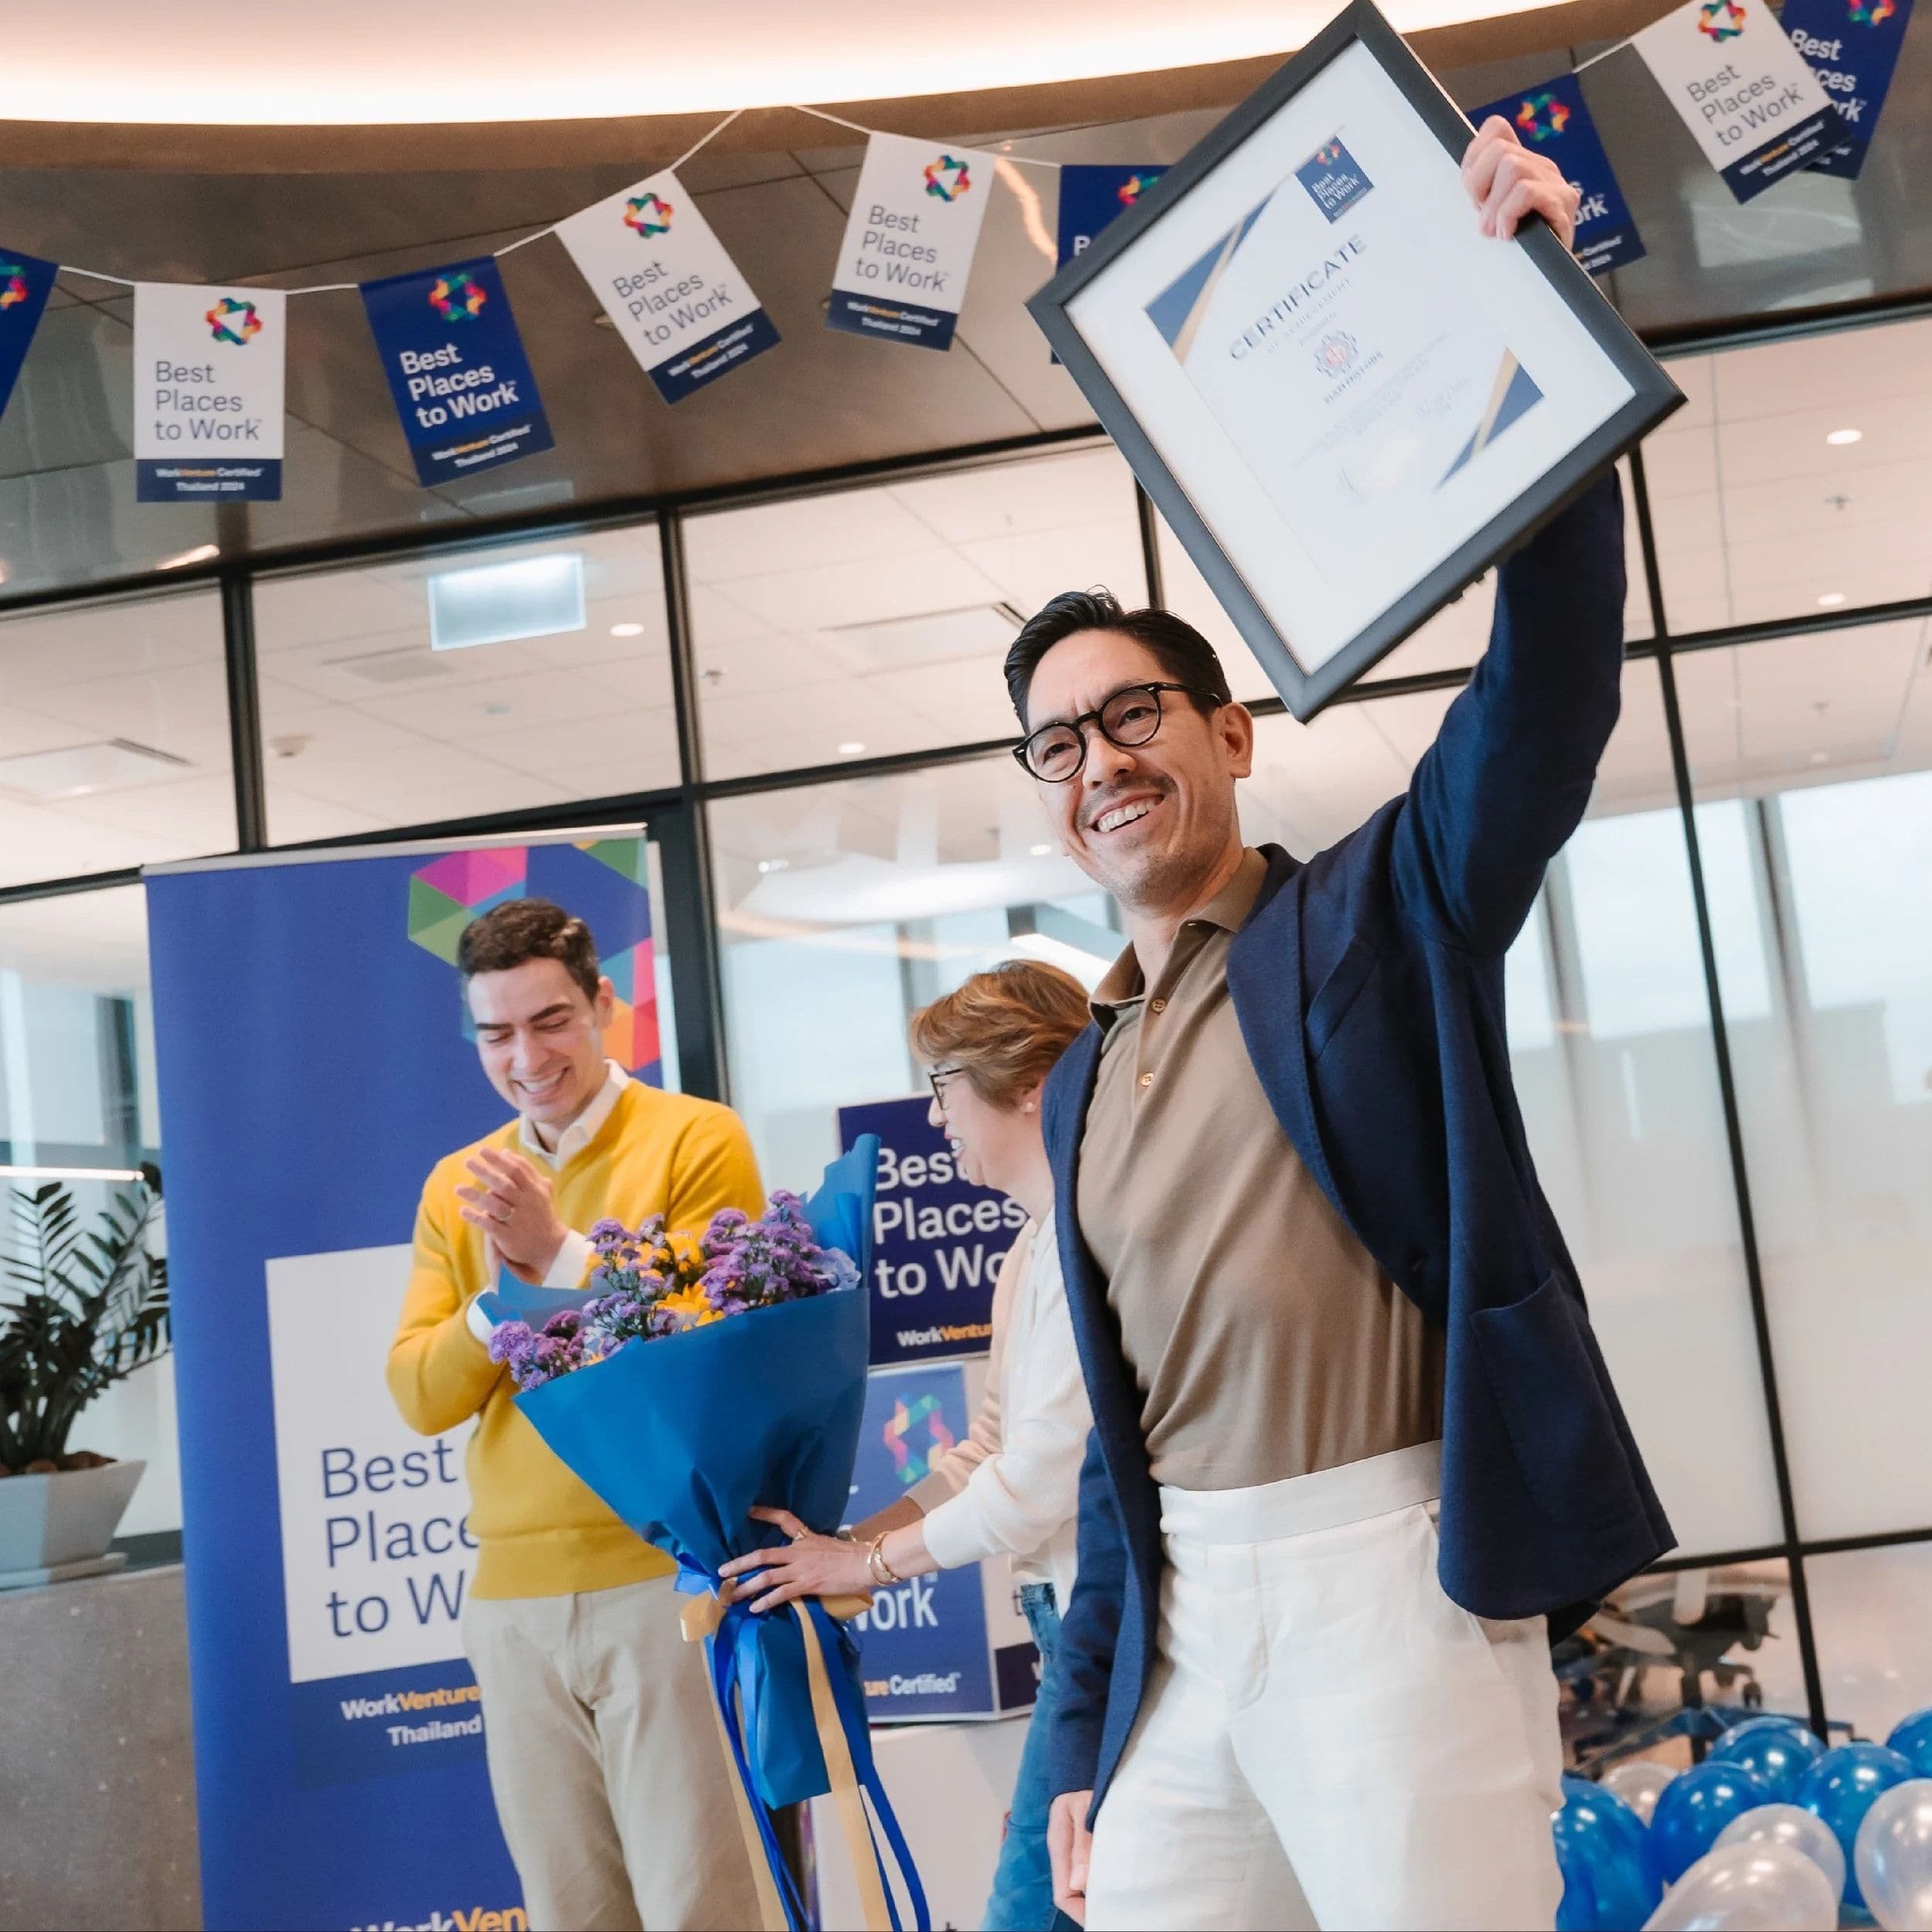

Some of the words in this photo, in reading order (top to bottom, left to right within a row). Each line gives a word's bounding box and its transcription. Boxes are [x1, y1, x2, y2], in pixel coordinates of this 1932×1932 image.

[1686, 64, 1741, 103] Best
[1700, 74, 1776, 124] Places
[1810, 66, 1857, 93] ces
[1716, 124, 1742, 147] to
[1743, 86, 1804, 129] Work
[868, 205, 920, 233] Best
[862, 230, 937, 264] Places
[613, 260, 668, 299] Best
[855, 258, 879, 279] to
[886, 261, 946, 292] Work
[628, 274, 705, 321] Places
[1229, 233, 1368, 359] CERTIFICATE
[644, 325, 672, 345] to
[668, 288, 733, 328] Work
[155, 360, 216, 383] Best
[400, 342, 463, 375] Best
[155, 389, 243, 412] Places
[407, 366, 495, 401] Places
[416, 406, 448, 428] to
[447, 383, 519, 419] Work
[154, 420, 182, 441] to
[189, 418, 260, 440] Work
[873, 1196, 1029, 1244] Places
[875, 1259, 927, 1298] to
[321, 1439, 457, 1498] Best
[325, 1592, 389, 1638] to
[340, 1685, 483, 1721] WorkVenture
[386, 1713, 483, 1747] Thailand
